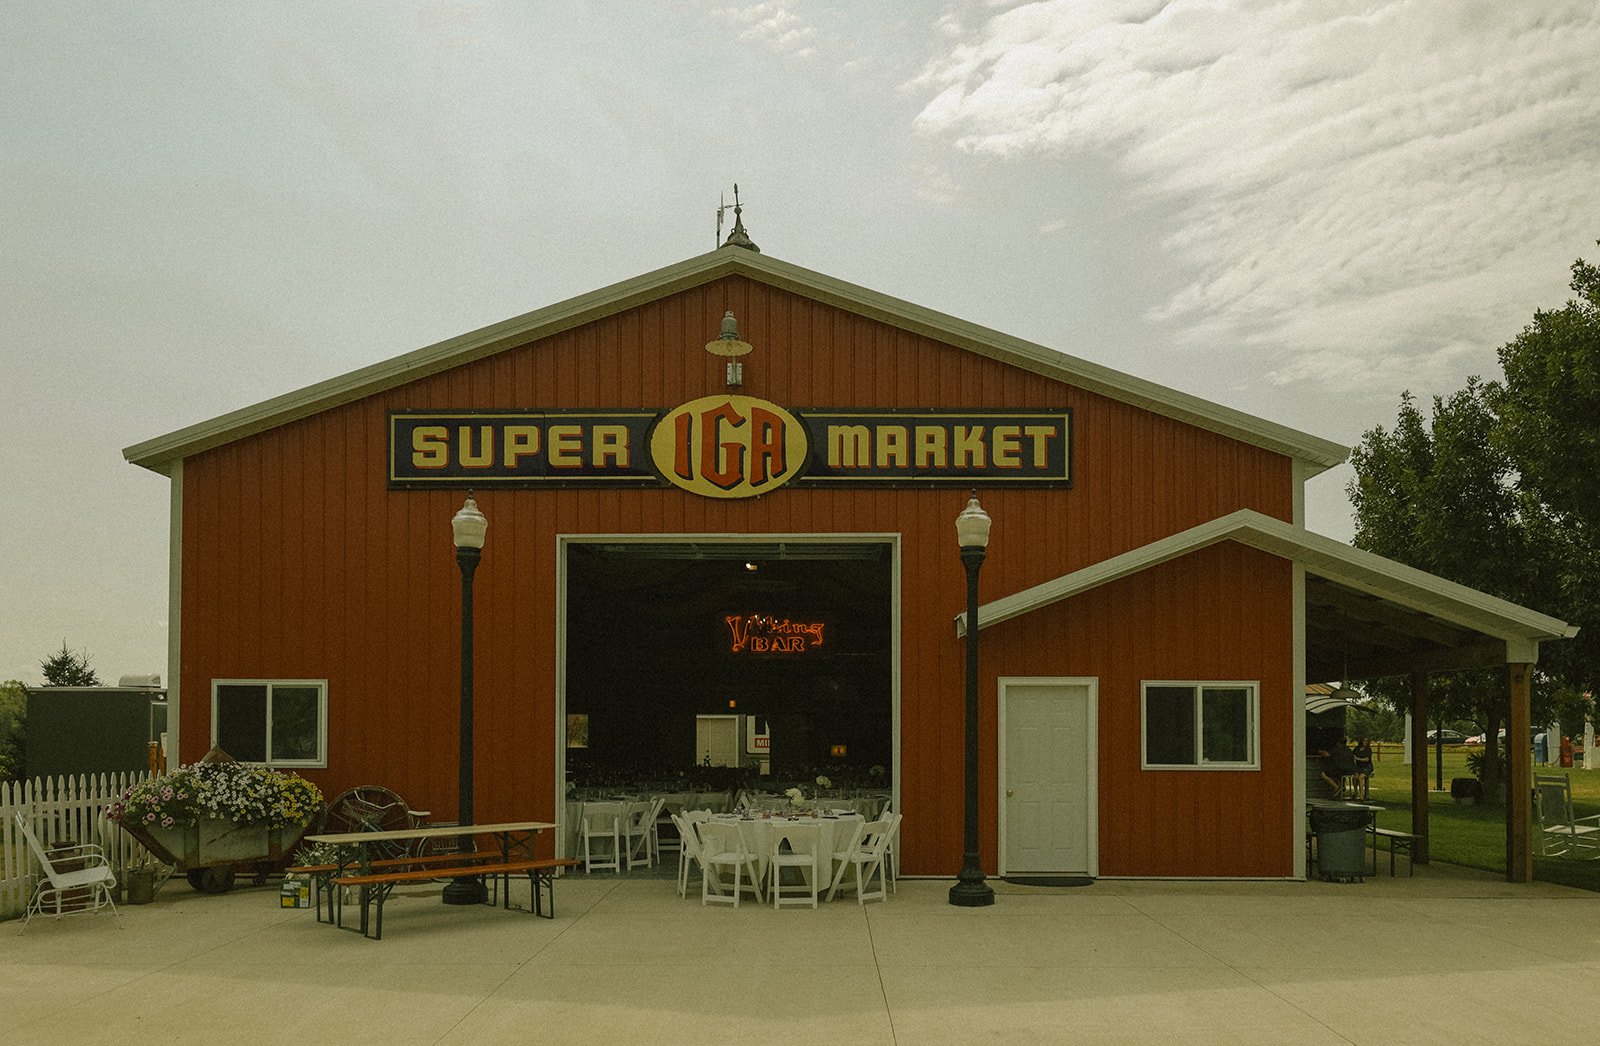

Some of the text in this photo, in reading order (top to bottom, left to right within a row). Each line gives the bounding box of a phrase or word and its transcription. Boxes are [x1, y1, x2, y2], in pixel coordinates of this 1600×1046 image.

[412, 402, 1057, 488] SUPER IGA MARKET
[726, 615, 825, 651] Vking
[751, 636, 804, 652] BAR
